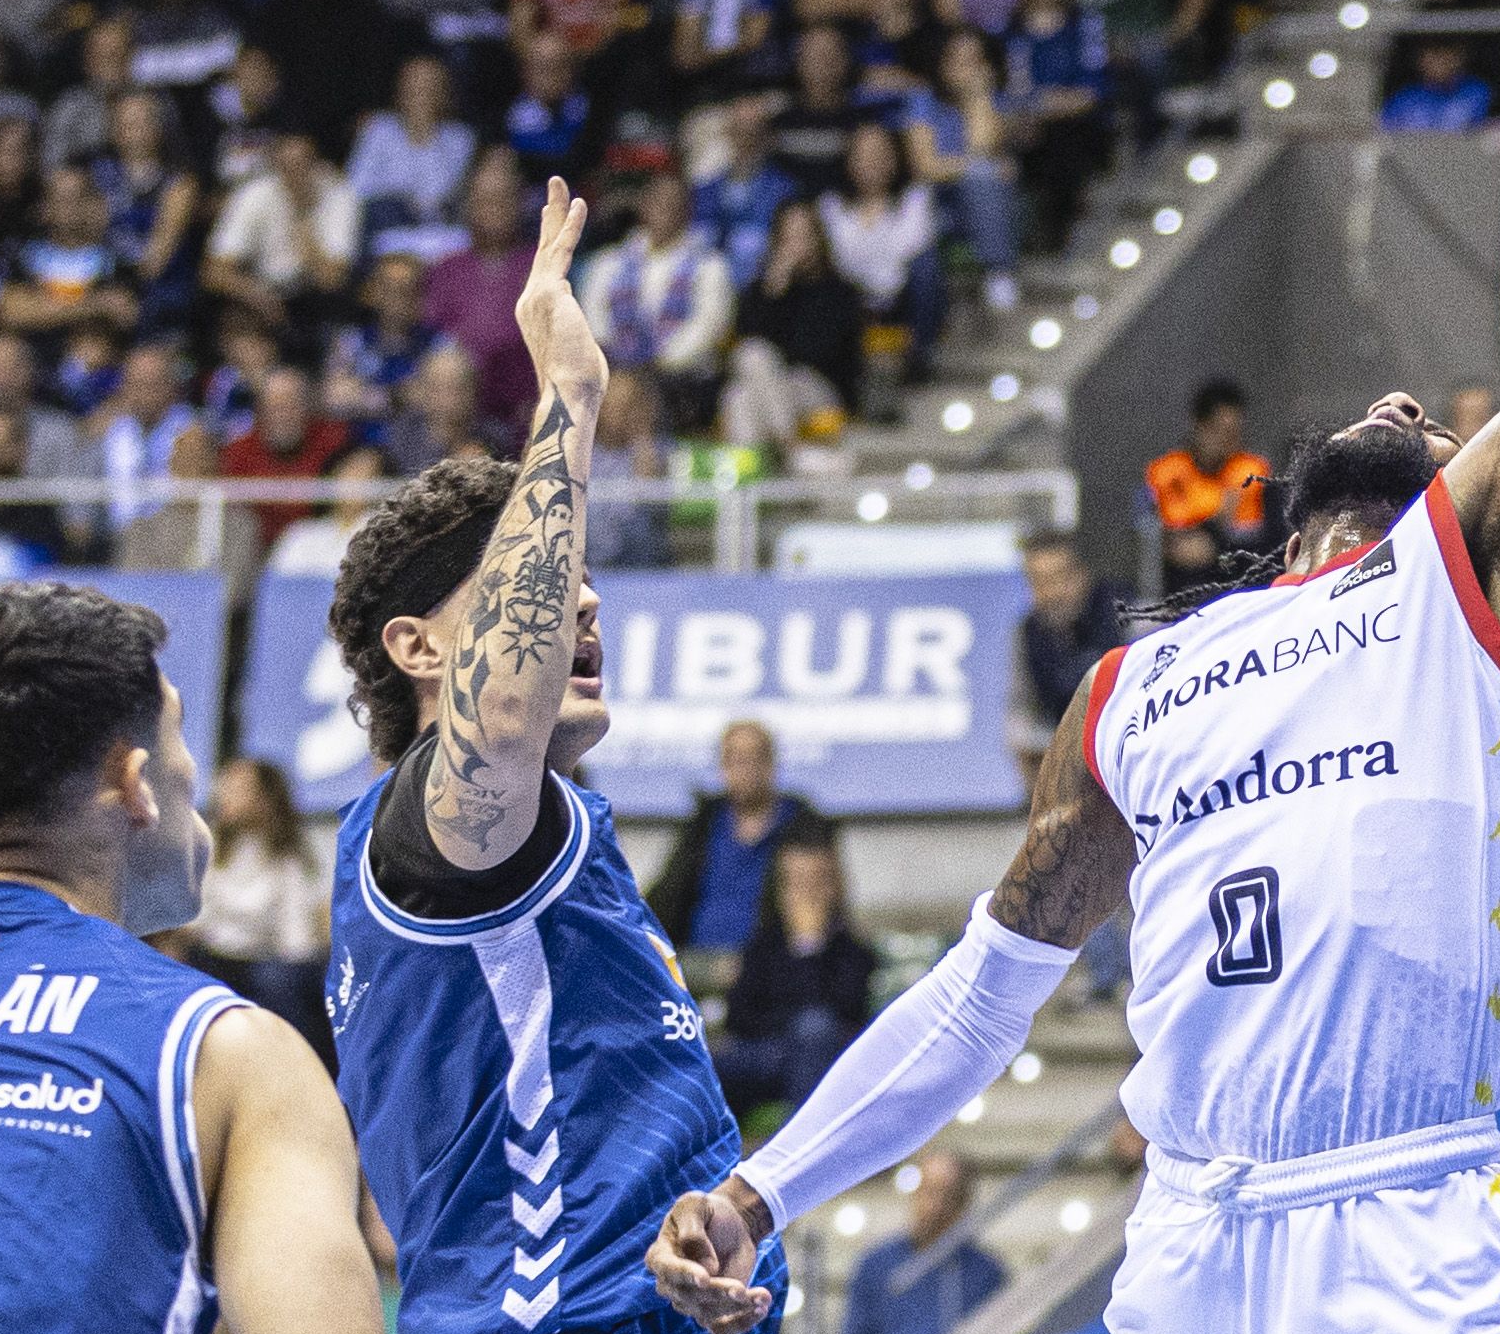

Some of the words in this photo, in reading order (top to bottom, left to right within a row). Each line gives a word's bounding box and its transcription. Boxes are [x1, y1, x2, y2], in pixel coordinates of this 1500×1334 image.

[620, 609, 975, 698] IBUR
[1143, 603, 1401, 733] MORABANC
[1170, 740, 1399, 826] Andorra
[1206, 866, 1281, 987] 0
